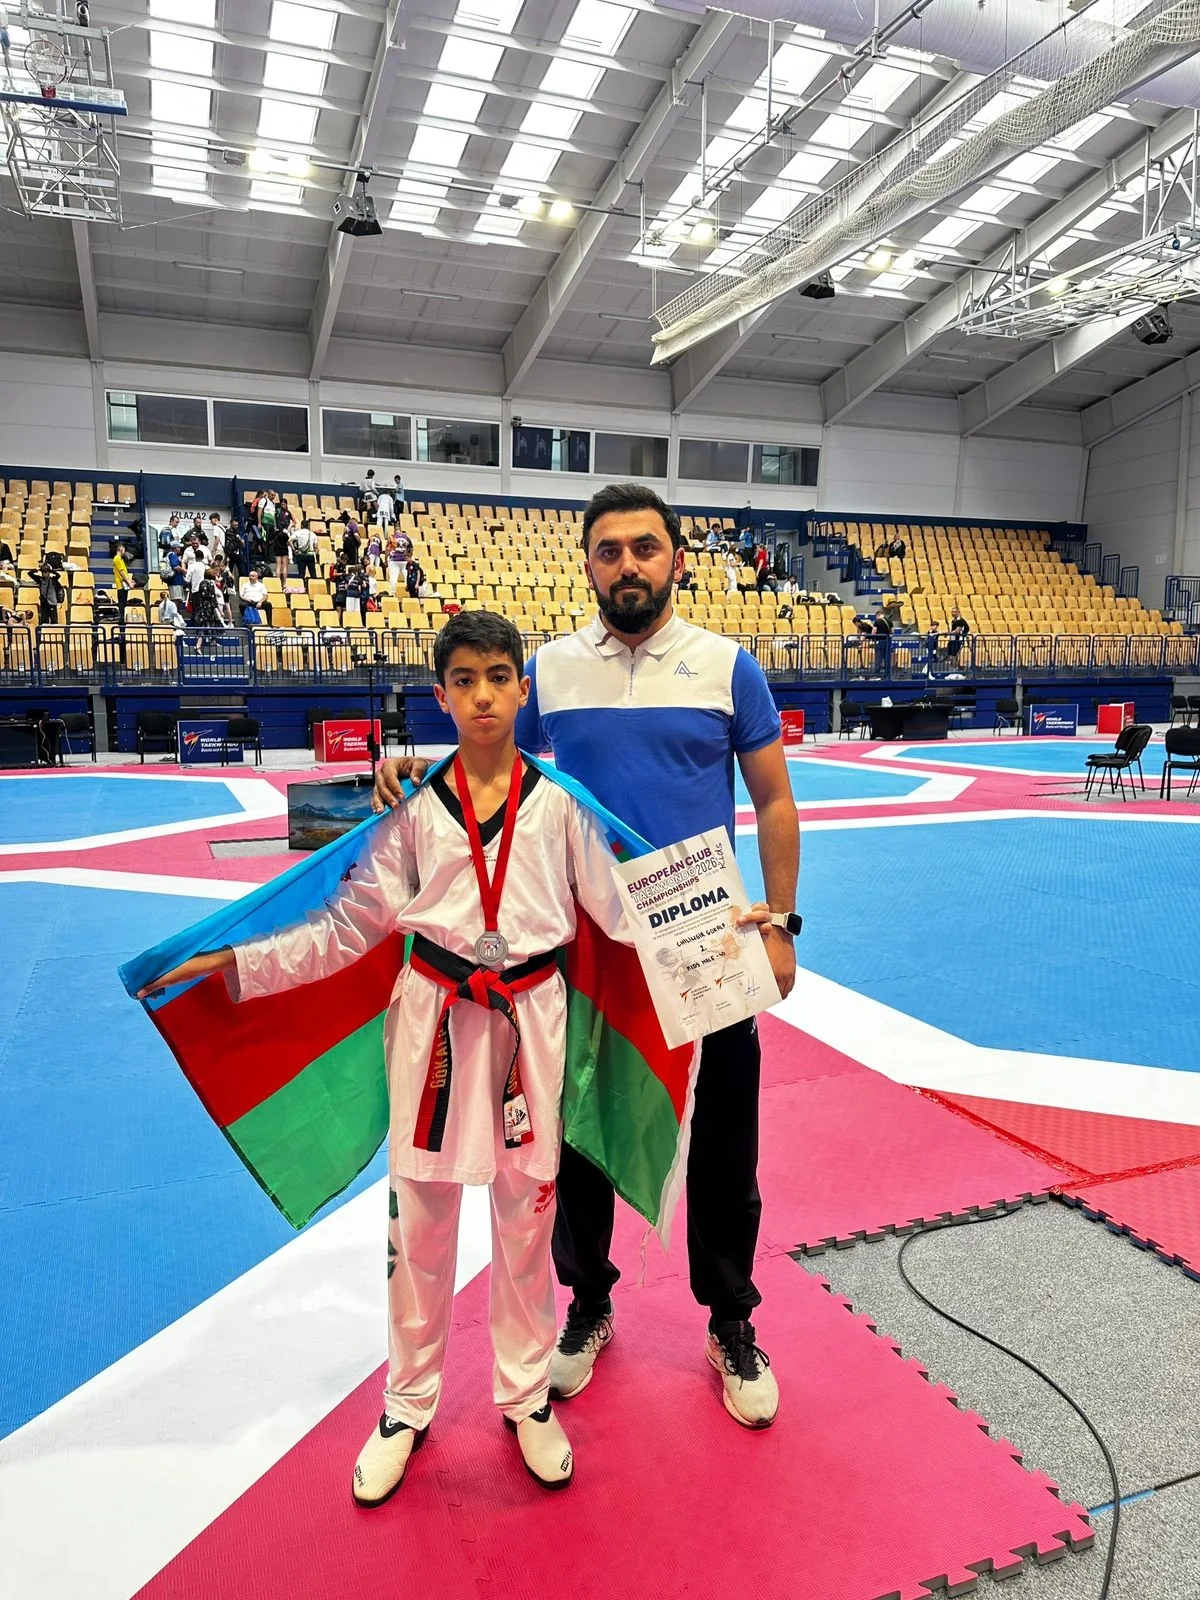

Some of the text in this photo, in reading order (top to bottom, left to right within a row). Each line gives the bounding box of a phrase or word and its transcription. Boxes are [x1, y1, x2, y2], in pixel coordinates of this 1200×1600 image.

[172, 511, 194, 519] IZLAZ
[627, 848, 712, 893] EUROPEAN CLUB
[631, 866, 696, 903] TAEKWONDO
[695, 857, 717, 875] 2026
[636, 876, 700, 910] CHAMPIONSHIPS
[648, 887, 730, 928] DIPLOMA
